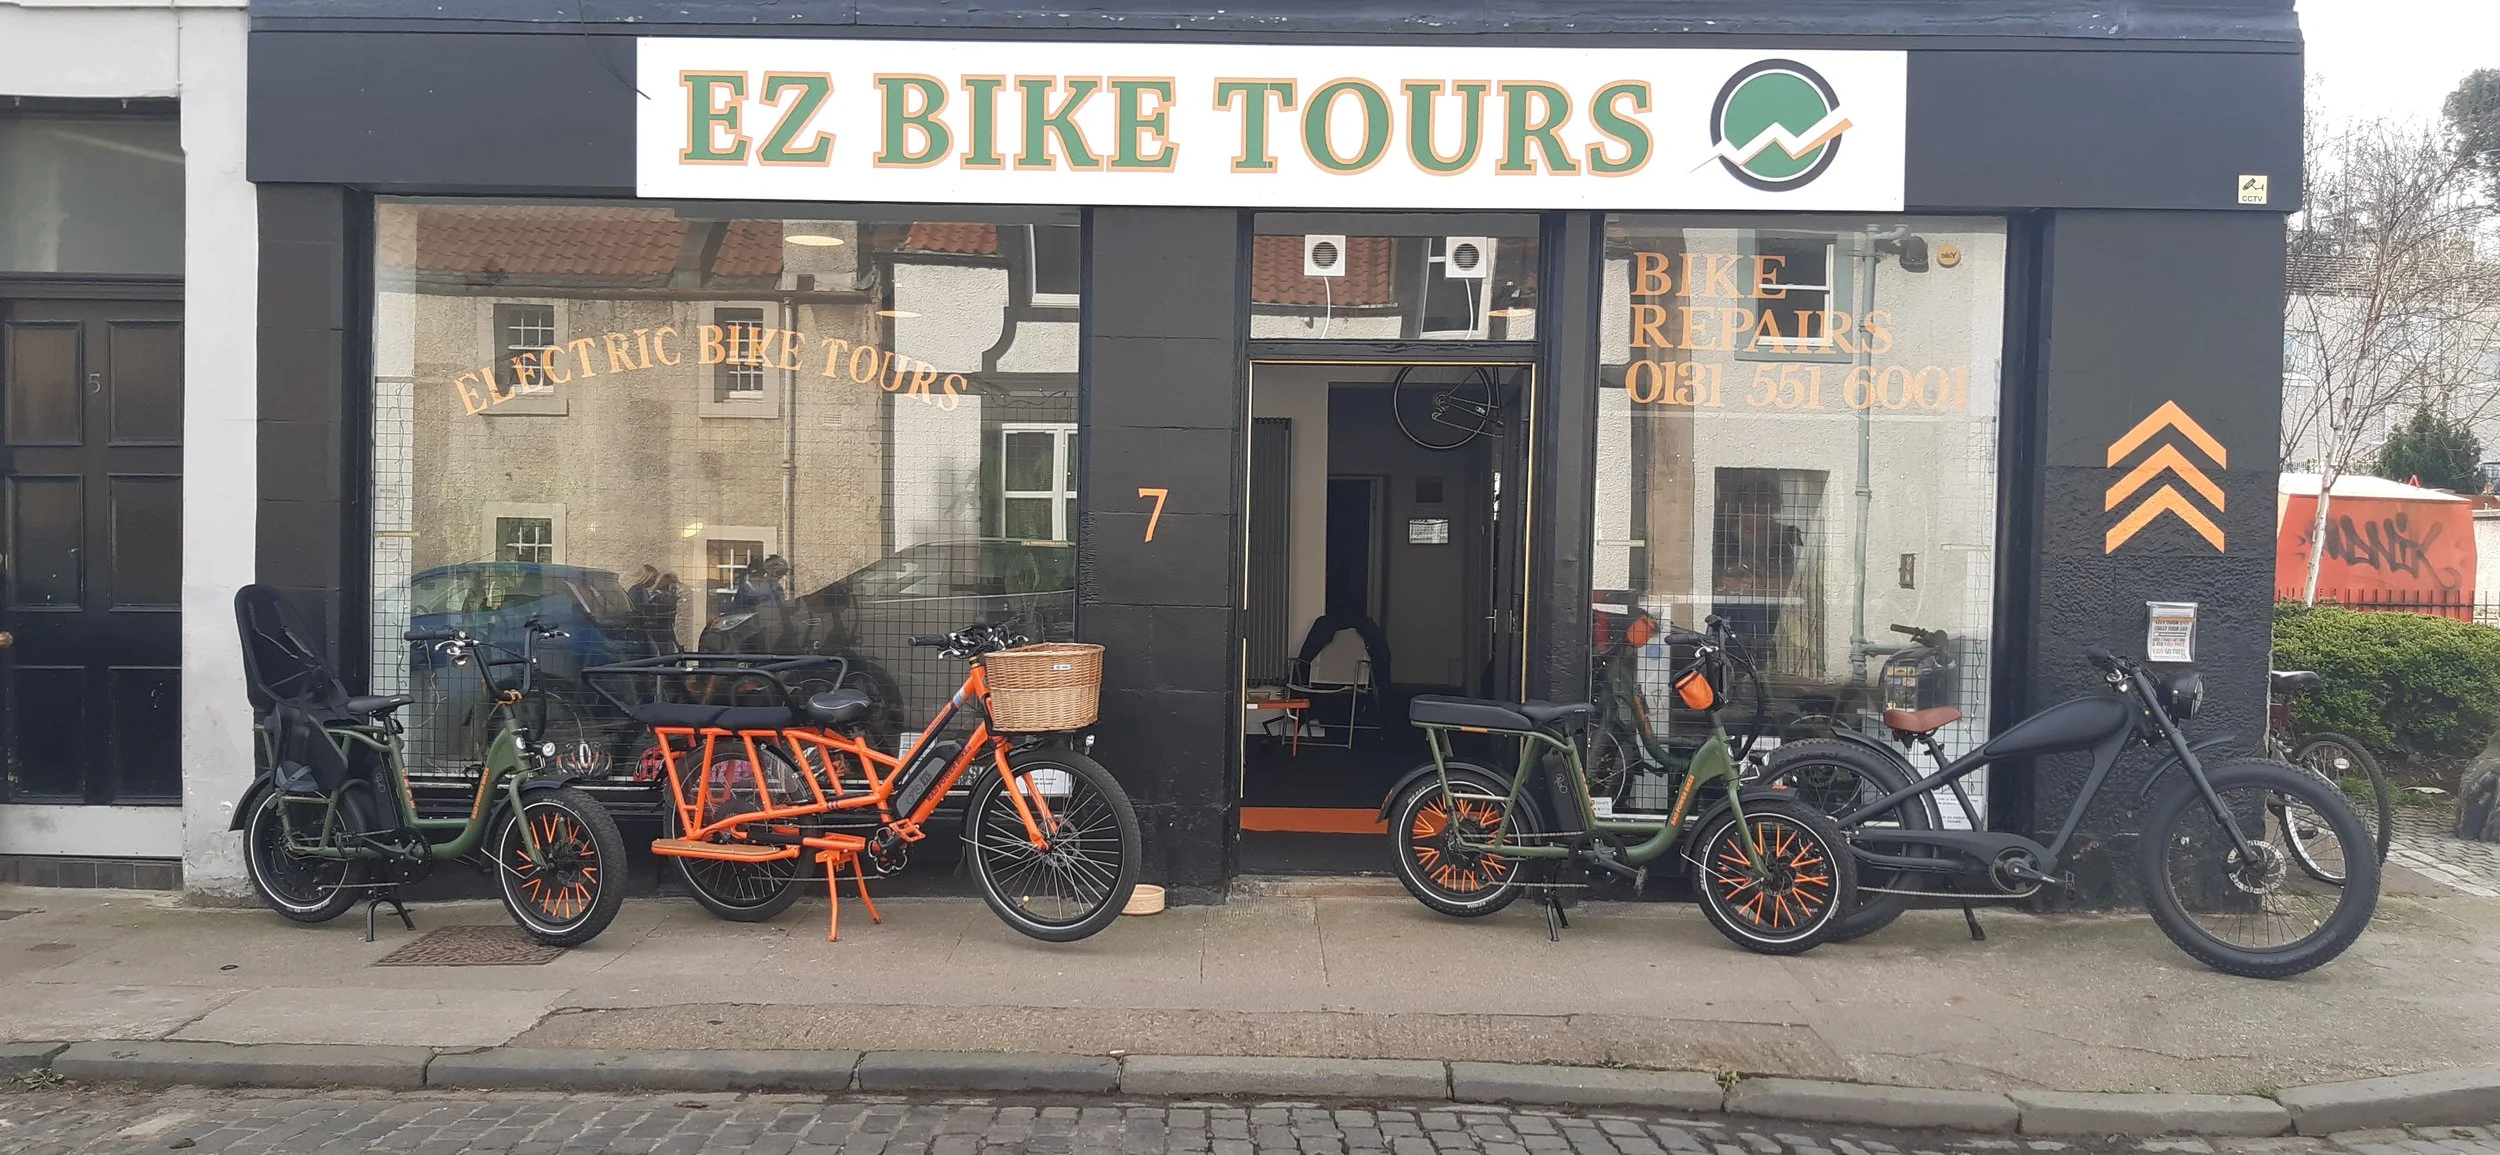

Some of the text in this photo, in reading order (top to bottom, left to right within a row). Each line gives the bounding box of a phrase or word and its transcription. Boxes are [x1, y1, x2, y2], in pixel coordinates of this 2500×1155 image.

[679, 70, 1654, 177] EZ BIKE TOURS
[1631, 251, 1787, 299] BIKE
[1631, 304, 1894, 355] REPAIRS
[89, 373, 101, 394] 5
[454, 324, 968, 416] ELECTRIC BIKE TOURS
[1625, 359, 1972, 411] 0131 551 6001
[1138, 487, 1169, 543] 7
[1675, 791, 1688, 813] POWER
[1683, 773, 1695, 792] BIKES
